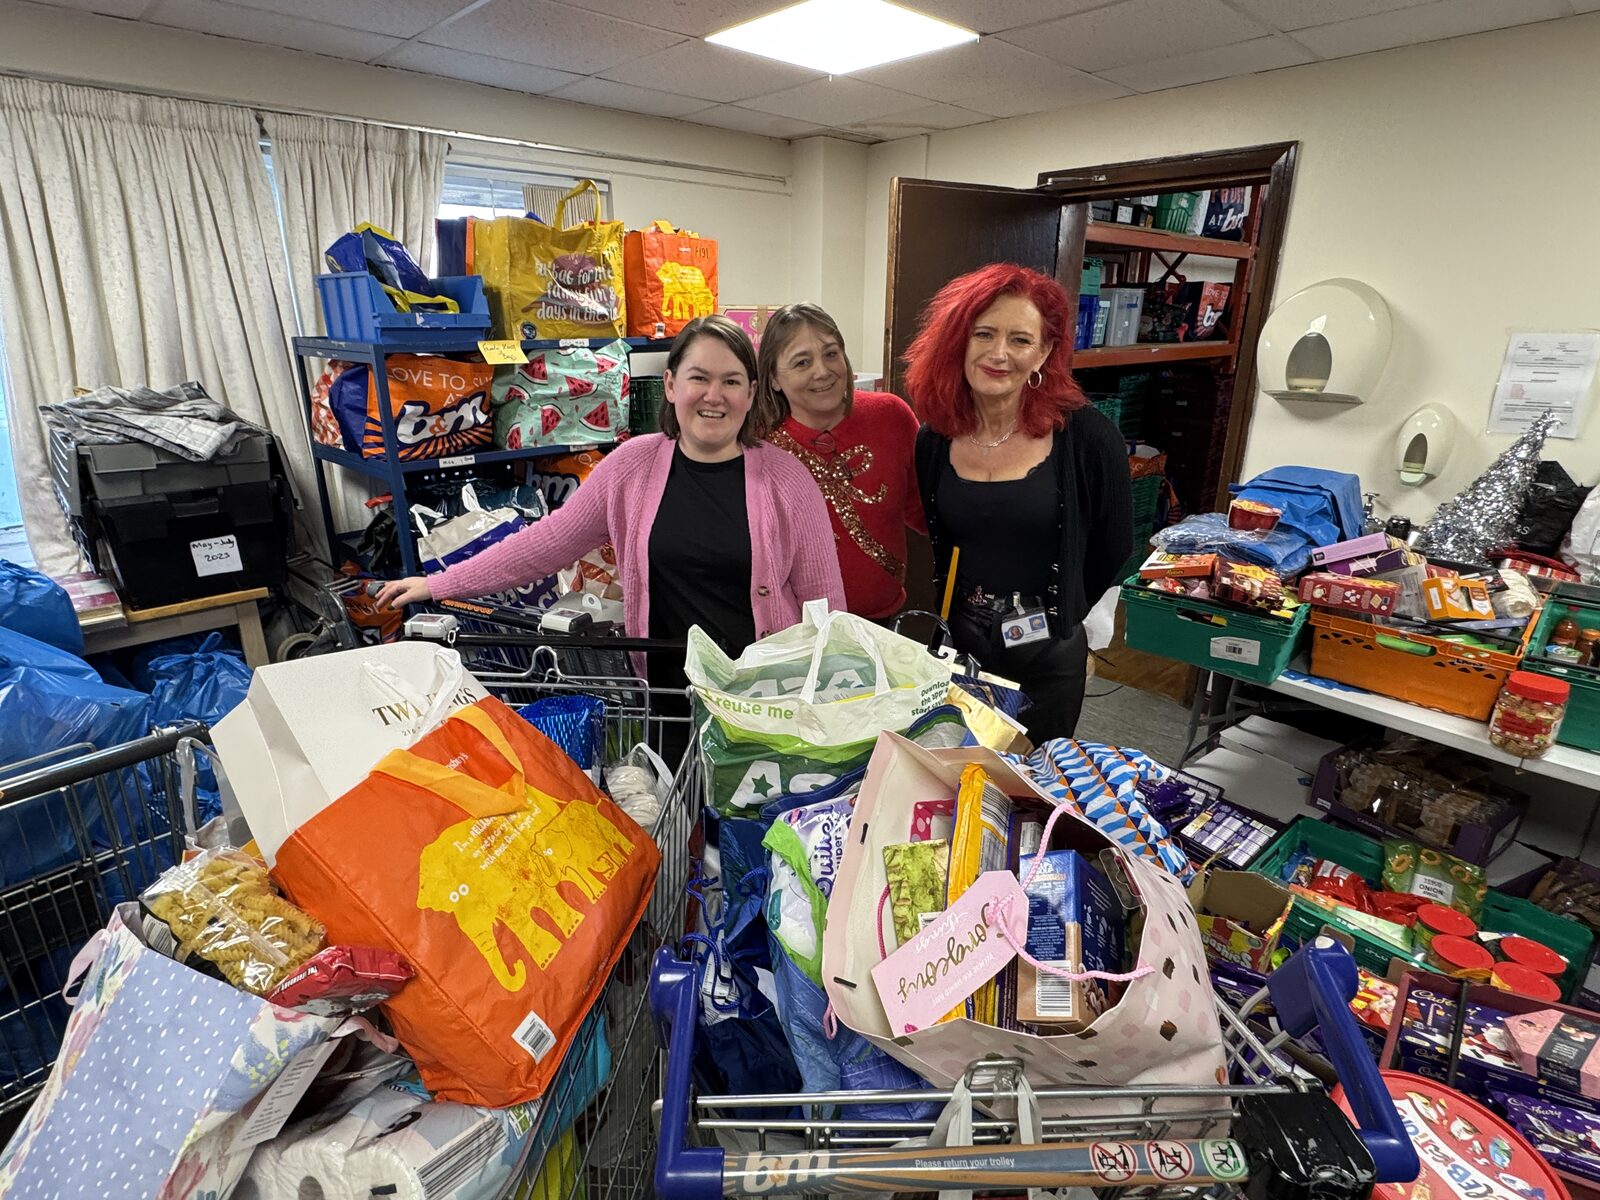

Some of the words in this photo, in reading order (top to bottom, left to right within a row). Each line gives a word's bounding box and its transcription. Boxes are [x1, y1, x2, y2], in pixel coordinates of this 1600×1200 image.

[536, 302, 567, 320] days
[569, 305, 581, 320] in
[439, 373, 466, 391] TO
[396, 396, 489, 445] b&m
[204, 552, 231, 562] 2023
[920, 680, 951, 698] Downloa
[920, 693, 933, 706] the
[933, 689, 945, 702] app
[716, 697, 762, 715] reuse
[768, 705, 794, 720] me
[446, 753, 469, 770] nsbury's
[1419, 884, 1444, 897] ONION
[1411, 988, 1477, 1017] Cadby
[743, 1150, 830, 1193] b&m
[914, 1159, 942, 1169] Please
[943, 1159, 968, 1169] return
[969, 1159, 988, 1170] your
[989, 1156, 1015, 1169] trolley
